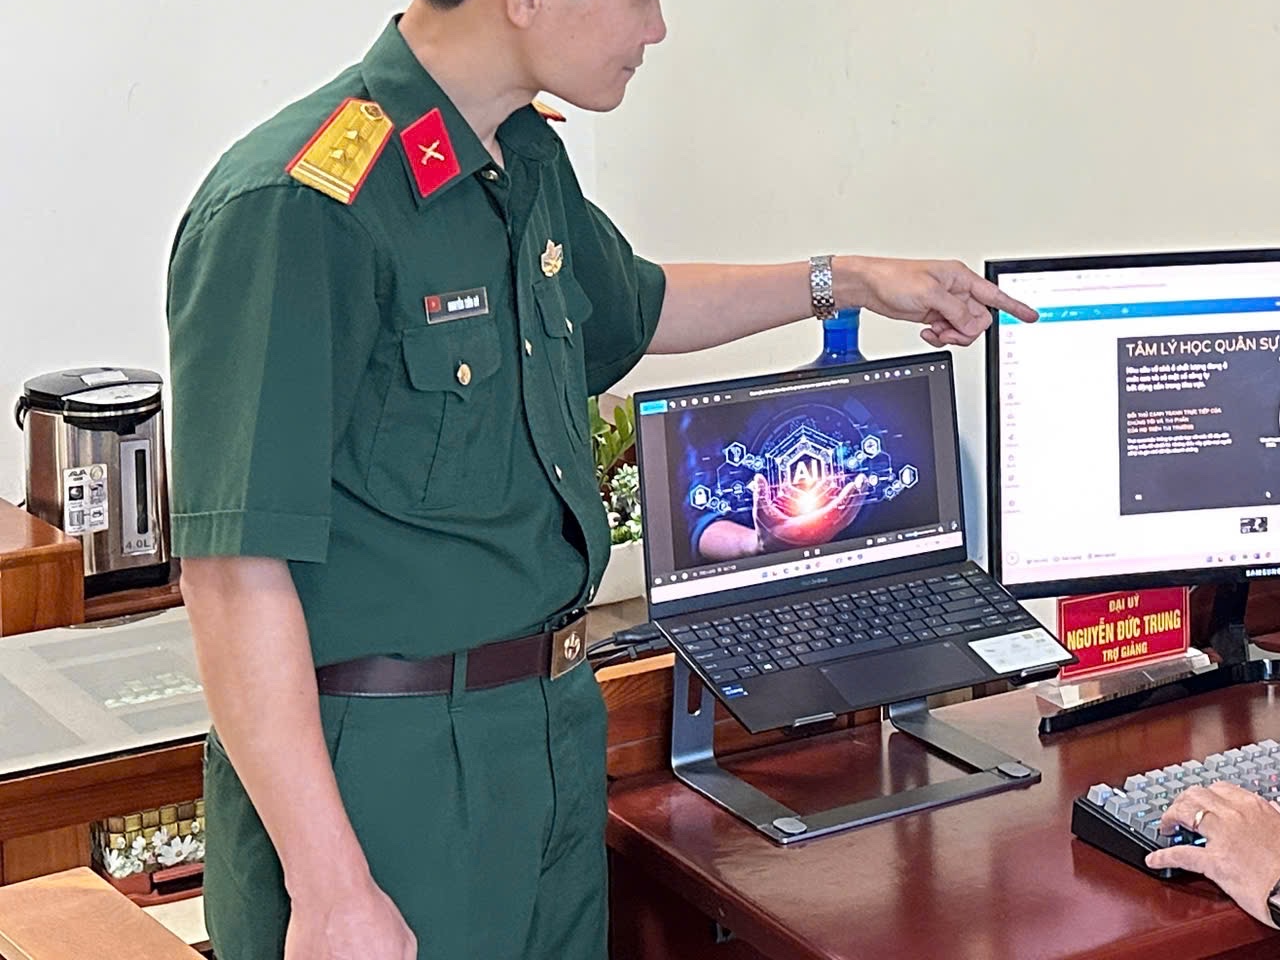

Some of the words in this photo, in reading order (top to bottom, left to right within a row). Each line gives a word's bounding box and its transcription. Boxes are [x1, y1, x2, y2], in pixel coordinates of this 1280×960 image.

[1126, 340, 1157, 358] TÂM
[1160, 338, 1177, 355] LÝ
[1180, 340, 1211, 356] HỌC
[1214, 335, 1256, 354] QUÂN
[1259, 334, 1280, 352] SỰ
[793, 459, 820, 482] AI
[1109, 599, 1125, 613] ĐẠI
[1067, 617, 1114, 651] NGUYỄN
[1117, 614, 1141, 640] ĐỨC
[1143, 609, 1181, 635] TRUNG
[1102, 646, 1119, 663] TRỢ
[1121, 640, 1148, 659] GIẢNG
